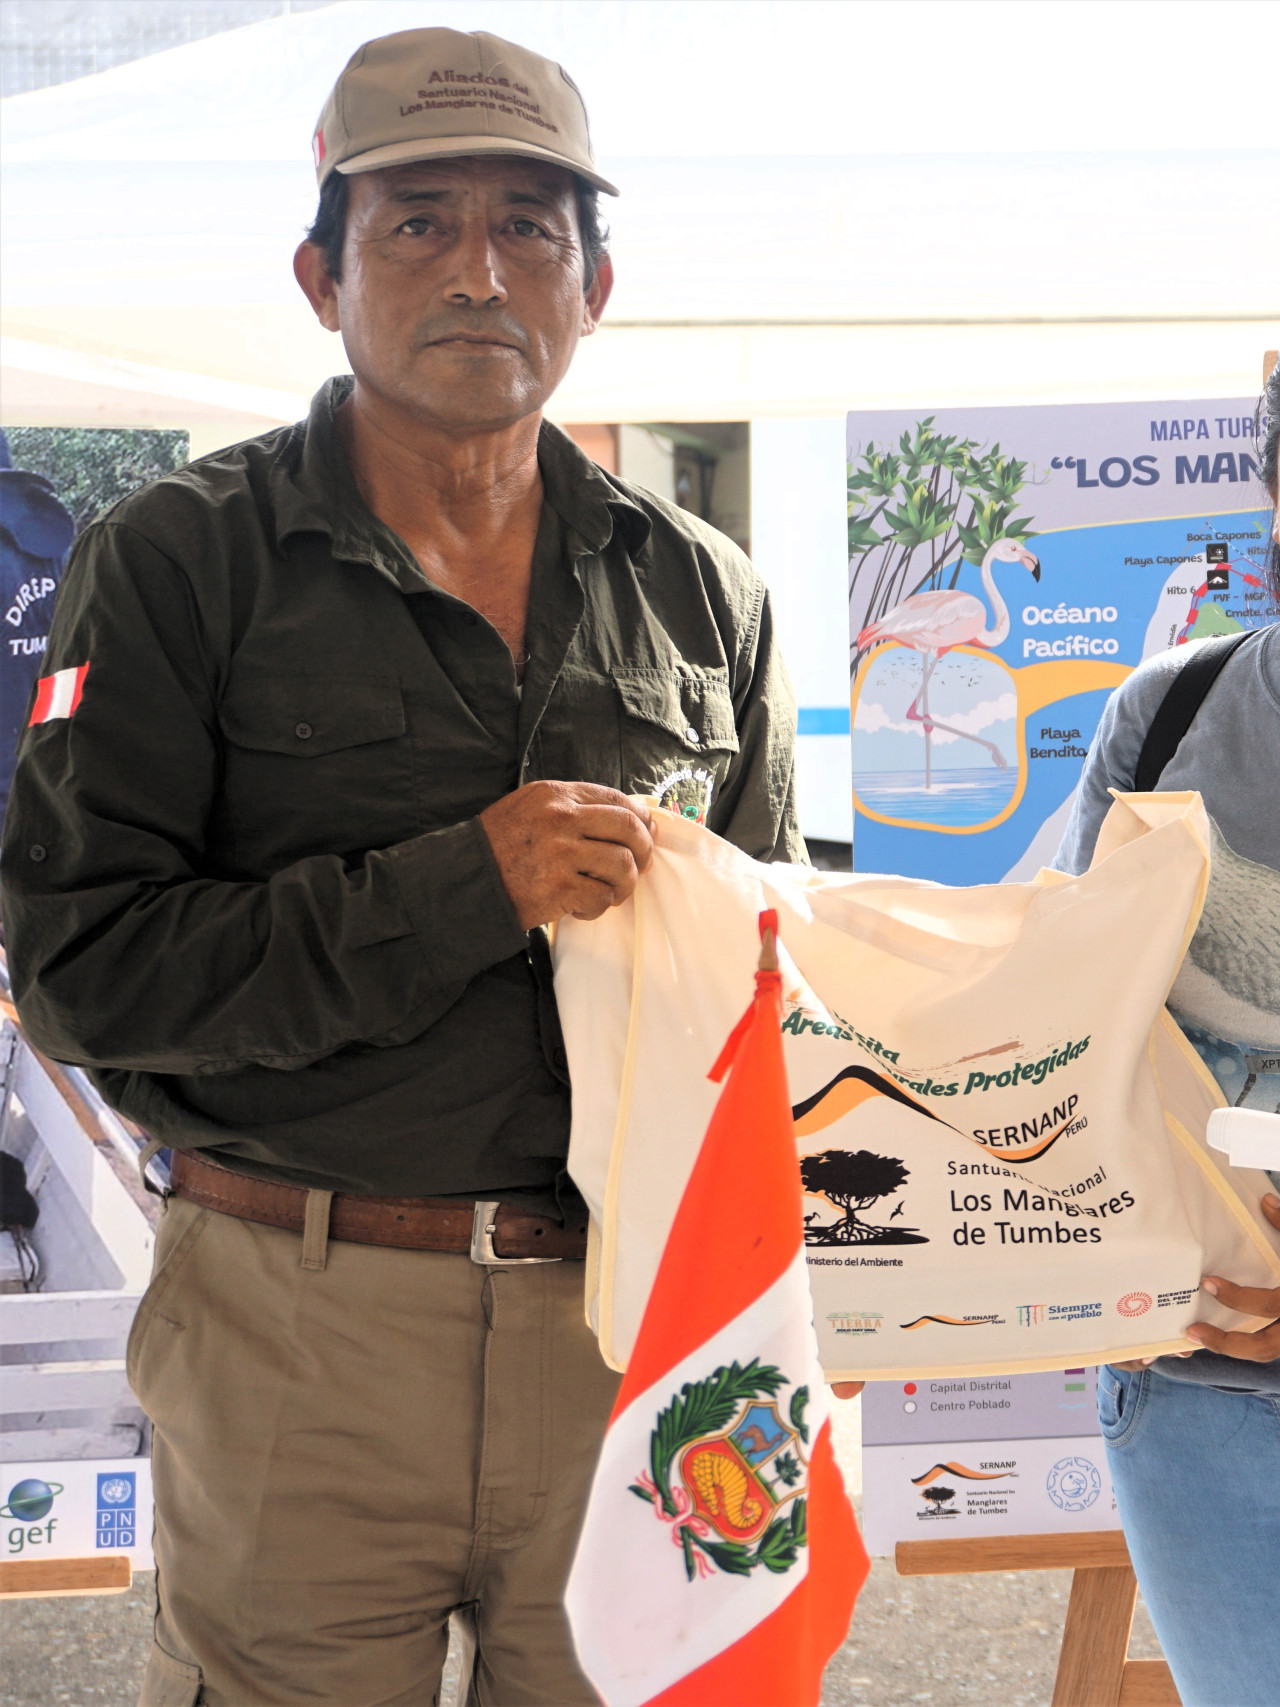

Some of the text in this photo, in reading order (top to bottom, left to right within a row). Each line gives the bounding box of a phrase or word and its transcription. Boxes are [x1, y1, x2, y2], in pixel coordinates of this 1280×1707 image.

[428, 70, 510, 88] Aliados
[418, 88, 540, 114] Santuario Nacional
[400, 102, 423, 117] Los
[498, 103, 514, 114] de
[515, 108, 558, 133] Tumbes
[1150, 418, 1210, 442] MAPA
[1187, 530, 1262, 542] Boca Capones
[1124, 554, 1202, 568] Playa Capones
[1167, 586, 1196, 595] Hito 6
[1214, 593, 1230, 602] PVF
[1022, 602, 1118, 626] Océano
[1226, 608, 1263, 618] Cmdte.
[1023, 634, 1119, 658] Pacífico
[1040, 728, 1082, 742] Playa
[1030, 746, 1086, 758] Bendito
[782, 1006, 853, 1041] Áreas
[963, 1034, 1092, 1095] Protegidas
[972, 1094, 1078, 1146] SERNANP
[1064, 1116, 1088, 1138] PERÚ
[1038, 1166, 1107, 1198] acional
[950, 1188, 1136, 1218] Los Manglares
[952, 1221, 1102, 1246] de Tumbes
[844, 1257, 858, 1266] del
[860, 1258, 903, 1267] Ambiente
[1172, 1294, 1192, 1302] PERÚ
[1048, 1302, 1102, 1314] Siempre
[963, 1314, 999, 1322] SERNANP
[1067, 1310, 1102, 1322] pueblo
[827, 1318, 882, 1329] TIERRA
[930, 1380, 1012, 1395] Capital Distrital
[930, 1400, 1011, 1412] Centro Poblado
[980, 1461, 1016, 1470] SERNANP
[967, 1499, 1008, 1507] Manglares
[8, 1518, 58, 1554] gef
